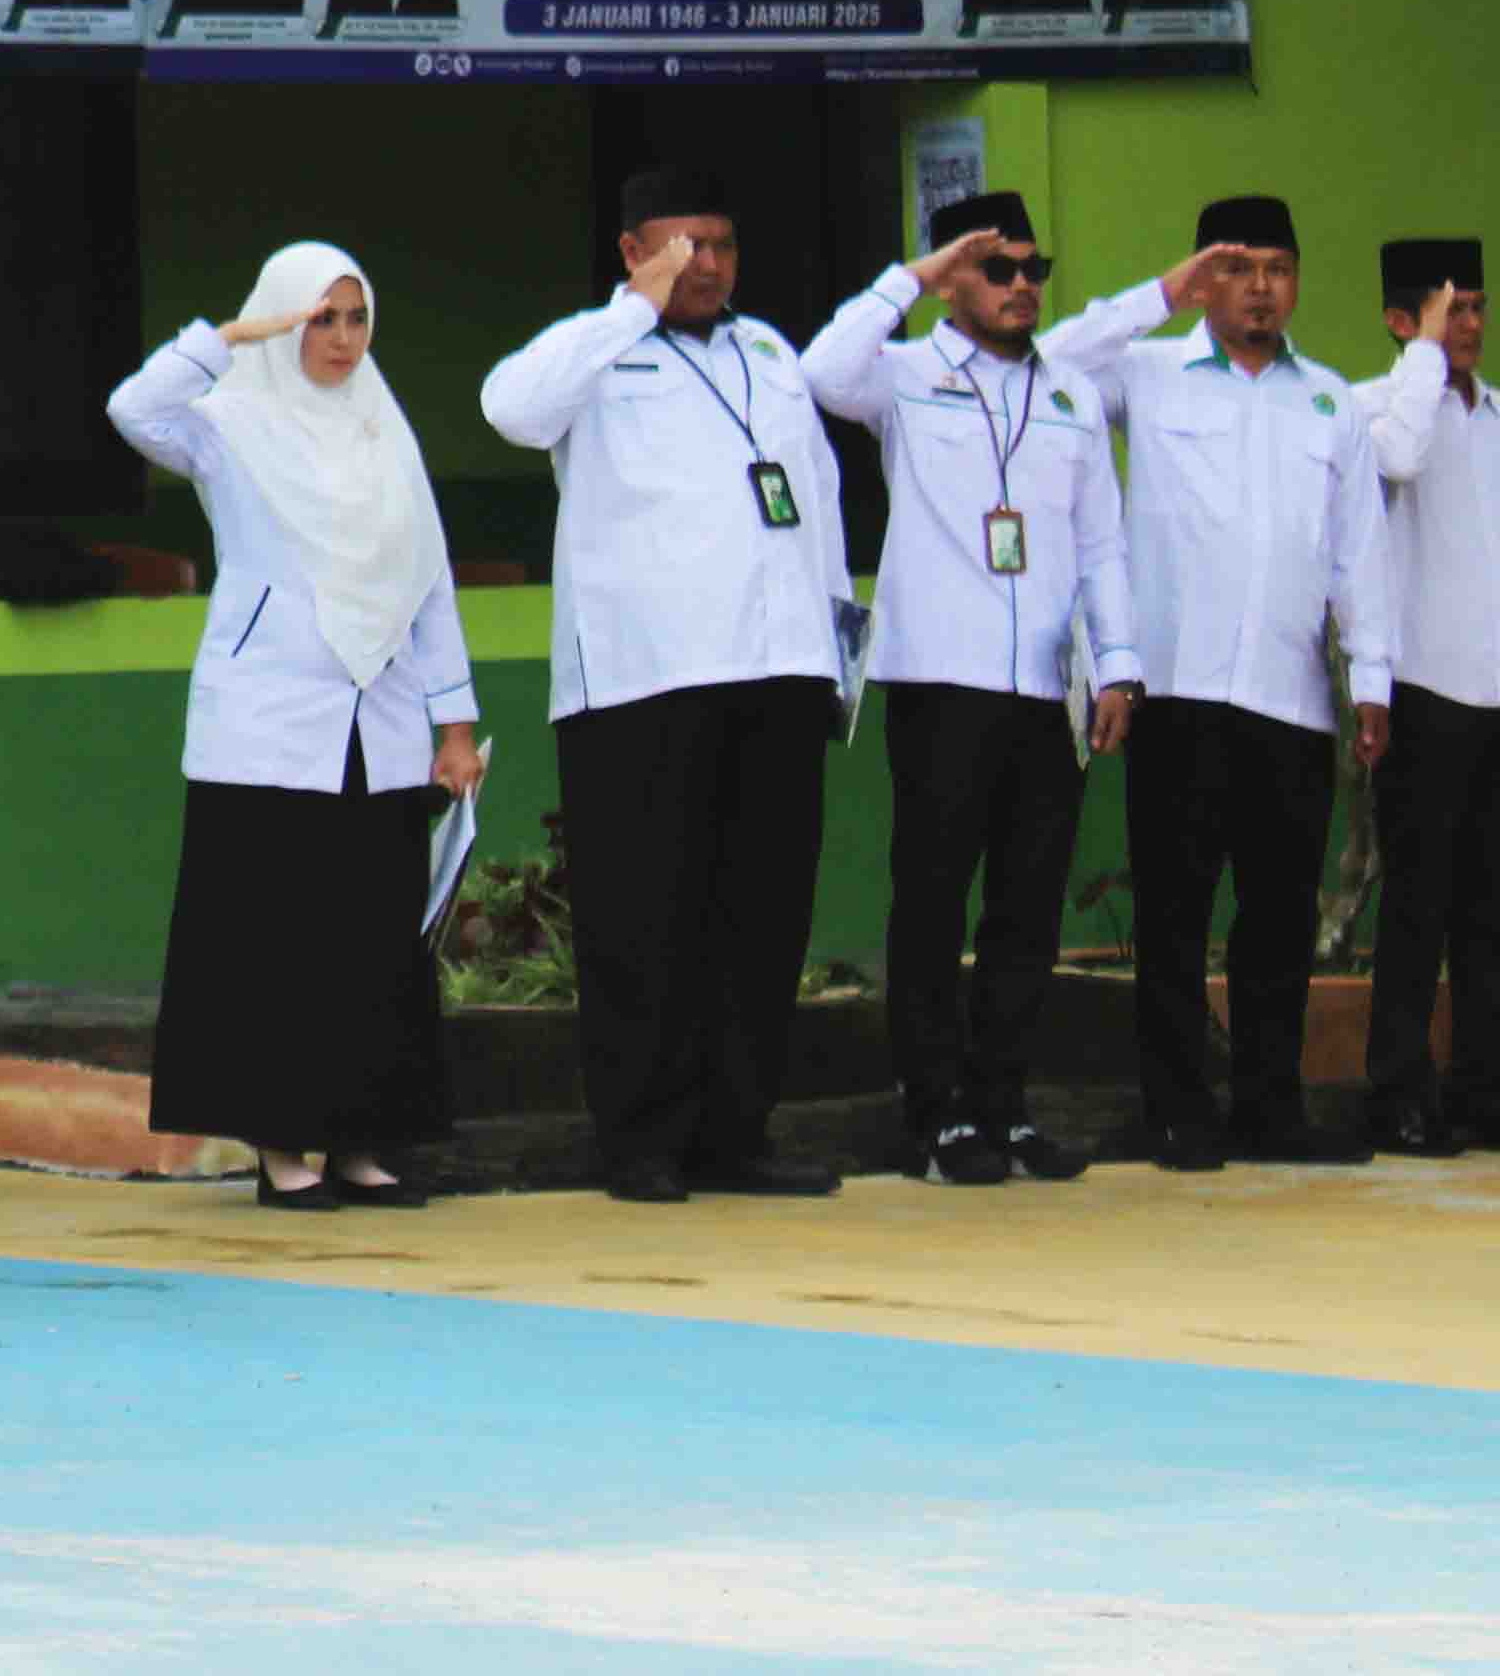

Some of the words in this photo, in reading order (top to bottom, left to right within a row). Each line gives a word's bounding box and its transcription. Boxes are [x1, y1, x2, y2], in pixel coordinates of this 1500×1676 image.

[542, 4, 557, 29] 3
[560, 4, 651, 29] JANUARI
[657, 3, 707, 29] 1946
[726, 3, 740, 29] 3
[746, 3, 827, 28] JANUARI
[832, 2, 882, 28] 2025
